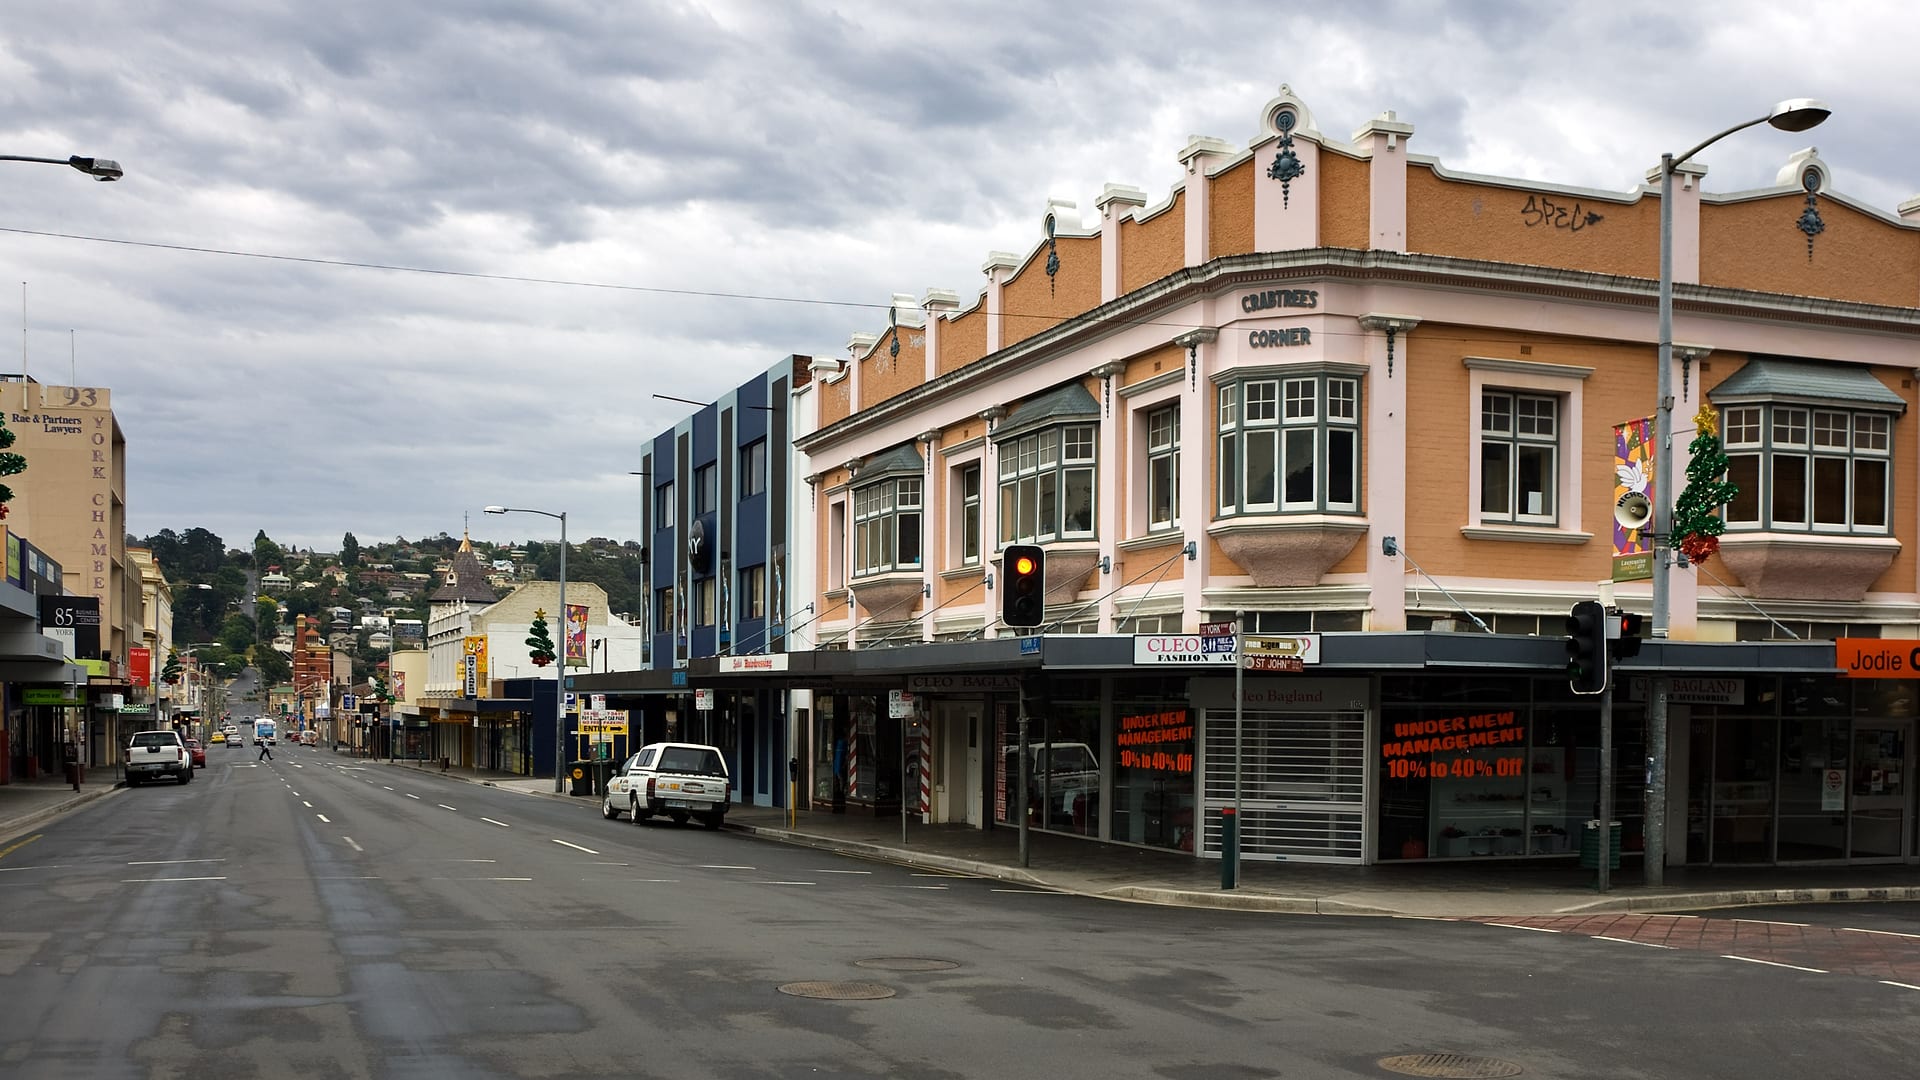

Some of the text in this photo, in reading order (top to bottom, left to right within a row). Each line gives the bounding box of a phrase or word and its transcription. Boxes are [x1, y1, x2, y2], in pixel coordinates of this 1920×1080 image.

[1241, 289, 1319, 313] CRABTREES
[1249, 327, 1311, 349] CORNER
[64, 386, 97, 407] 93
[12, 413, 82, 425] Rae & Partners
[44, 424, 82, 435] Lawyers
[91, 416, 106, 479] YORK
[55, 607, 73, 626] 85
[1207, 624, 1221, 634] YORK
[1147, 637, 1200, 652] CLEO
[1157, 654, 1209, 662] FASHION
[1255, 658, 1266, 668] ST
[1268, 659, 1287, 669] JOHN
[1851, 650, 1902, 671] Jodie
[912, 676, 954, 688] CLEO
[1672, 679, 1737, 694] BAGLAND
[1268, 689, 1323, 705] Bagland
[1123, 710, 1186, 731] UNDER NEW
[1394, 712, 1514, 738] UNDER NEW
[1118, 726, 1193, 746] MANAGEMENT
[1383, 727, 1524, 758] MANAGEMENT
[1121, 750, 1192, 772] 10% to 40% Off
[1388, 758, 1524, 778] 10% to 40% Off
